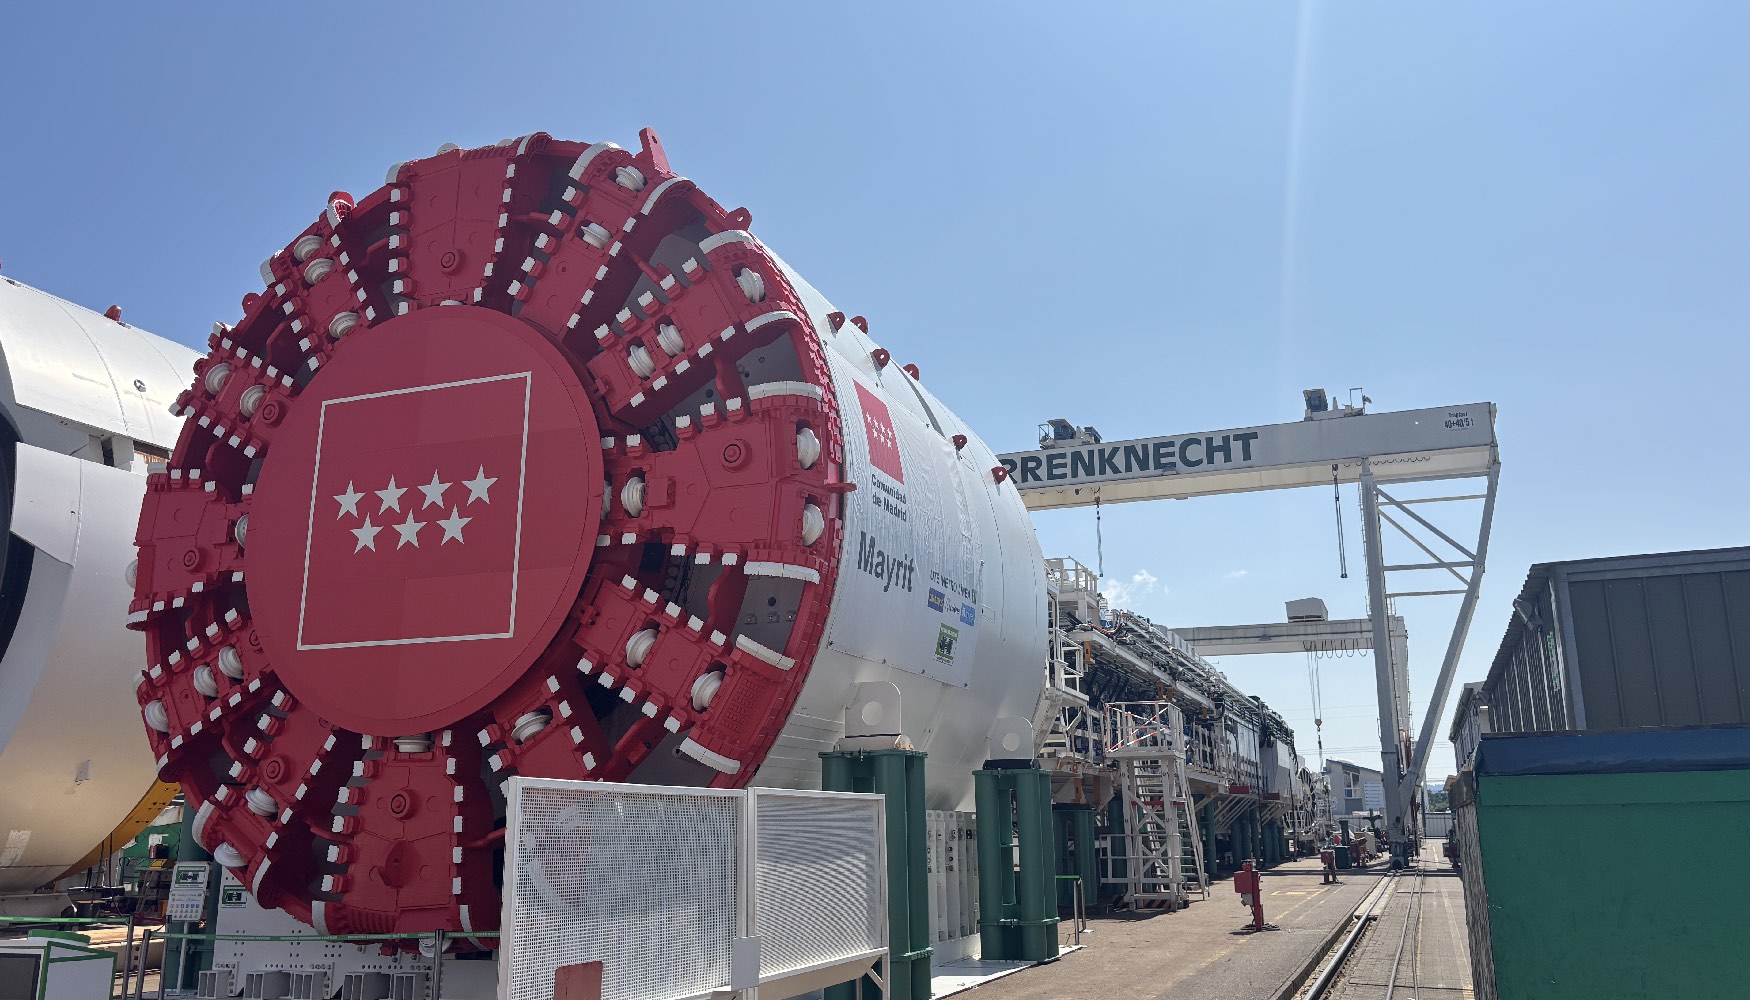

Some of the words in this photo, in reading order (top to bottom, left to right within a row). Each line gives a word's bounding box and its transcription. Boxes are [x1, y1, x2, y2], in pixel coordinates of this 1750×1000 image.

[871, 473, 907, 505] Comunidad
[872, 491, 882, 507] de
[883, 496, 907, 523] Madrid
[857, 530, 914, 593] Mayrit
